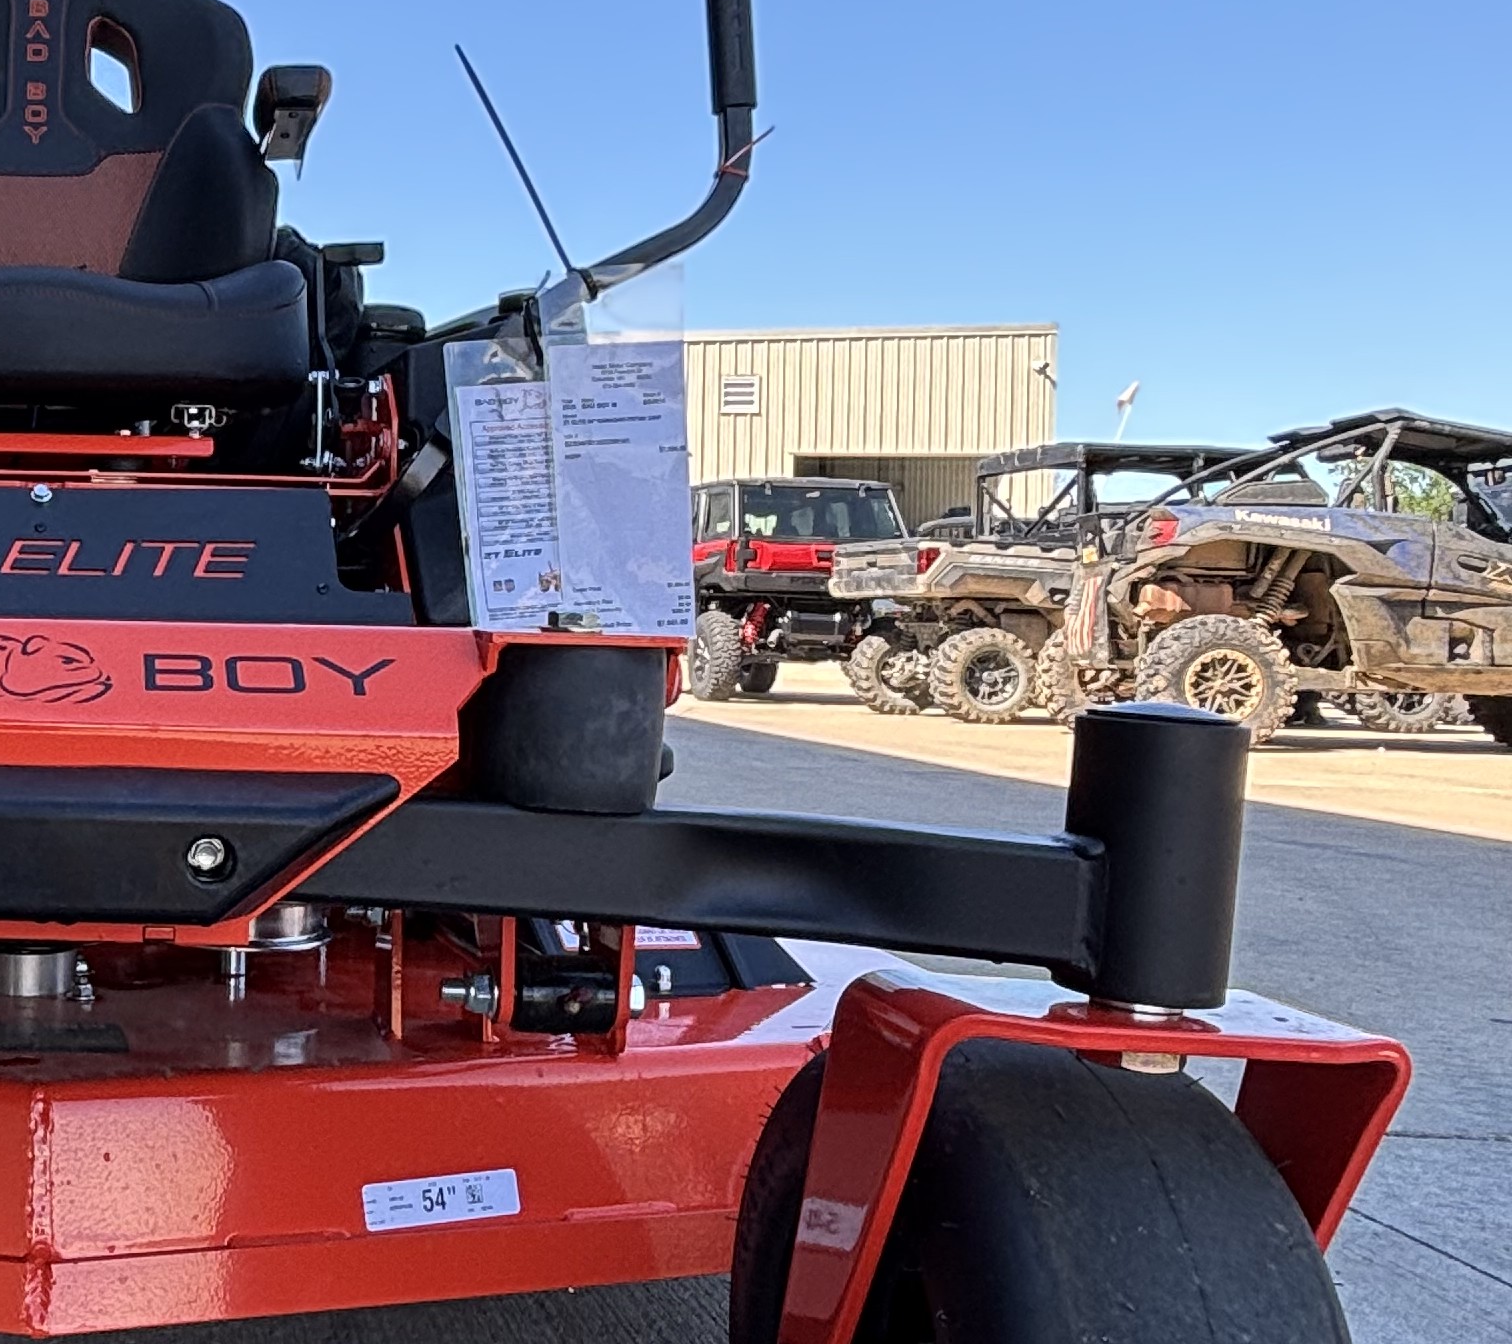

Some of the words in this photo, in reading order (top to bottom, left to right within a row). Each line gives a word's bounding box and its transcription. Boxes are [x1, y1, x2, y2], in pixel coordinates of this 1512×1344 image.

[26, 0, 50, 62] BAD
[23, 81, 48, 144] BOY
[1234, 509, 1332, 532] Kawasaki
[142, 651, 398, 697] BOY
[421, 1185, 456, 1213] 54"
